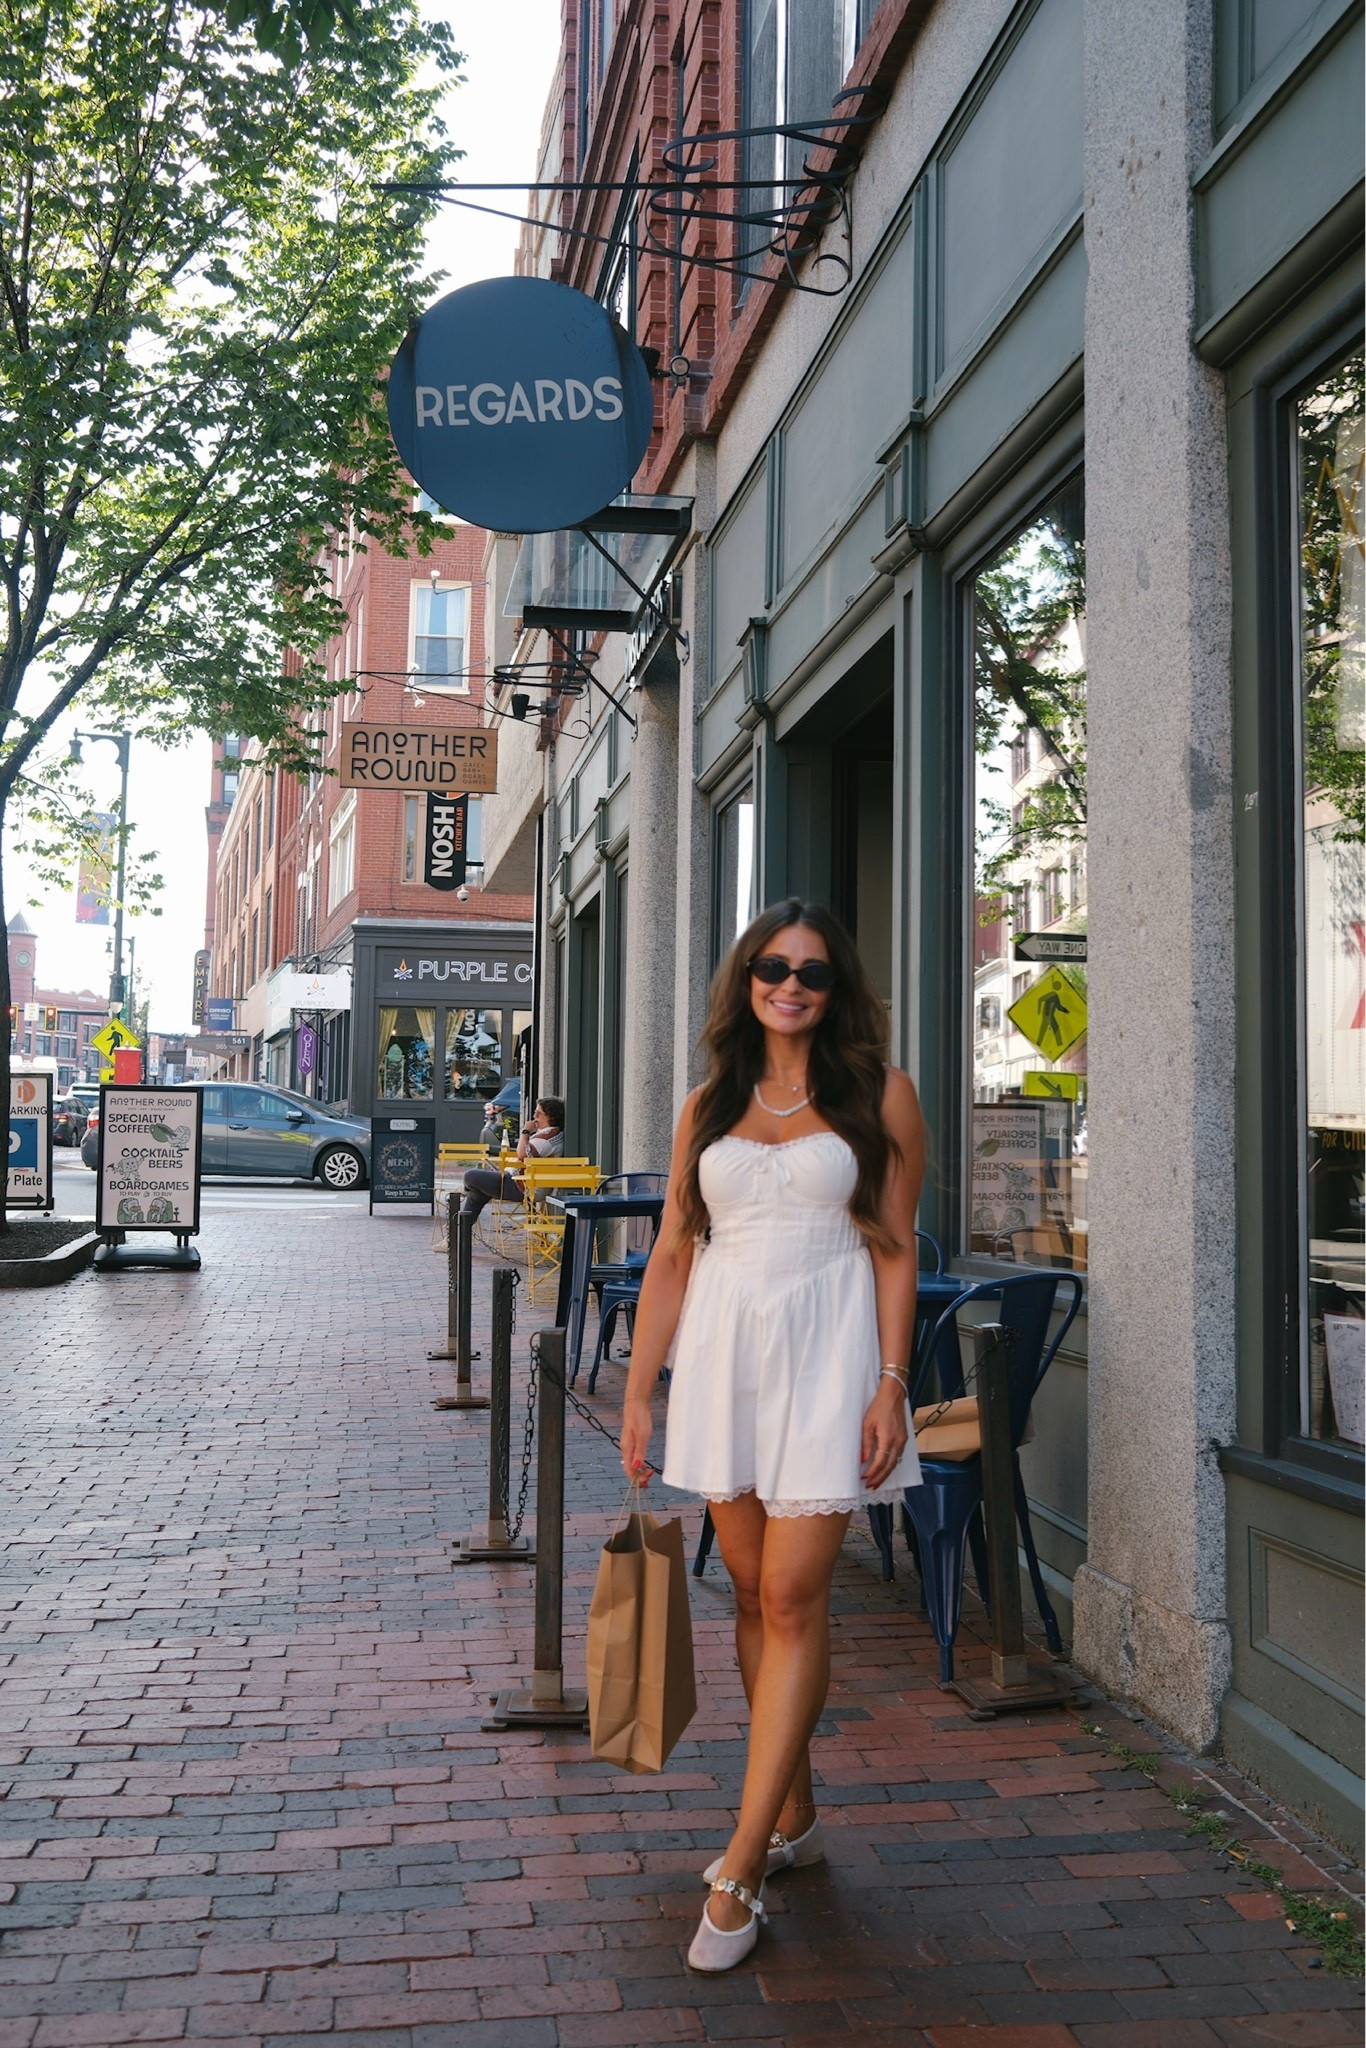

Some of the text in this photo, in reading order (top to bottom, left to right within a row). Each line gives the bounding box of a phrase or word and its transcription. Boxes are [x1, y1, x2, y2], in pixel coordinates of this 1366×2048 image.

[415, 376, 623, 428] REGARDS
[351, 731, 488, 759] ANOTHER
[351, 757, 456, 783] ROUND
[454, 806, 464, 852] KITCHEN BAR
[431, 805, 455, 878] NOSH
[418, 960, 534, 983] PURPLE C
[194, 956, 205, 1021] EMPIRE
[232, 1037, 246, 1045] 561
[301, 1034, 313, 1067] OPEN
[110, 1097, 192, 1107] ANOTHER ROUND
[10, 1106, 48, 1116] ARKING
[108, 1113, 166, 1123] SPECIALTY
[108, 1124, 150, 1134] COFFEE
[1321, 1131, 1337, 1148] FOR
[121, 1148, 183, 1158] COCKTAILS
[148, 1160, 183, 1169] BEERS
[14, 1174, 43, 1186] Plate
[109, 1181, 189, 1191] BOARDGAMES
